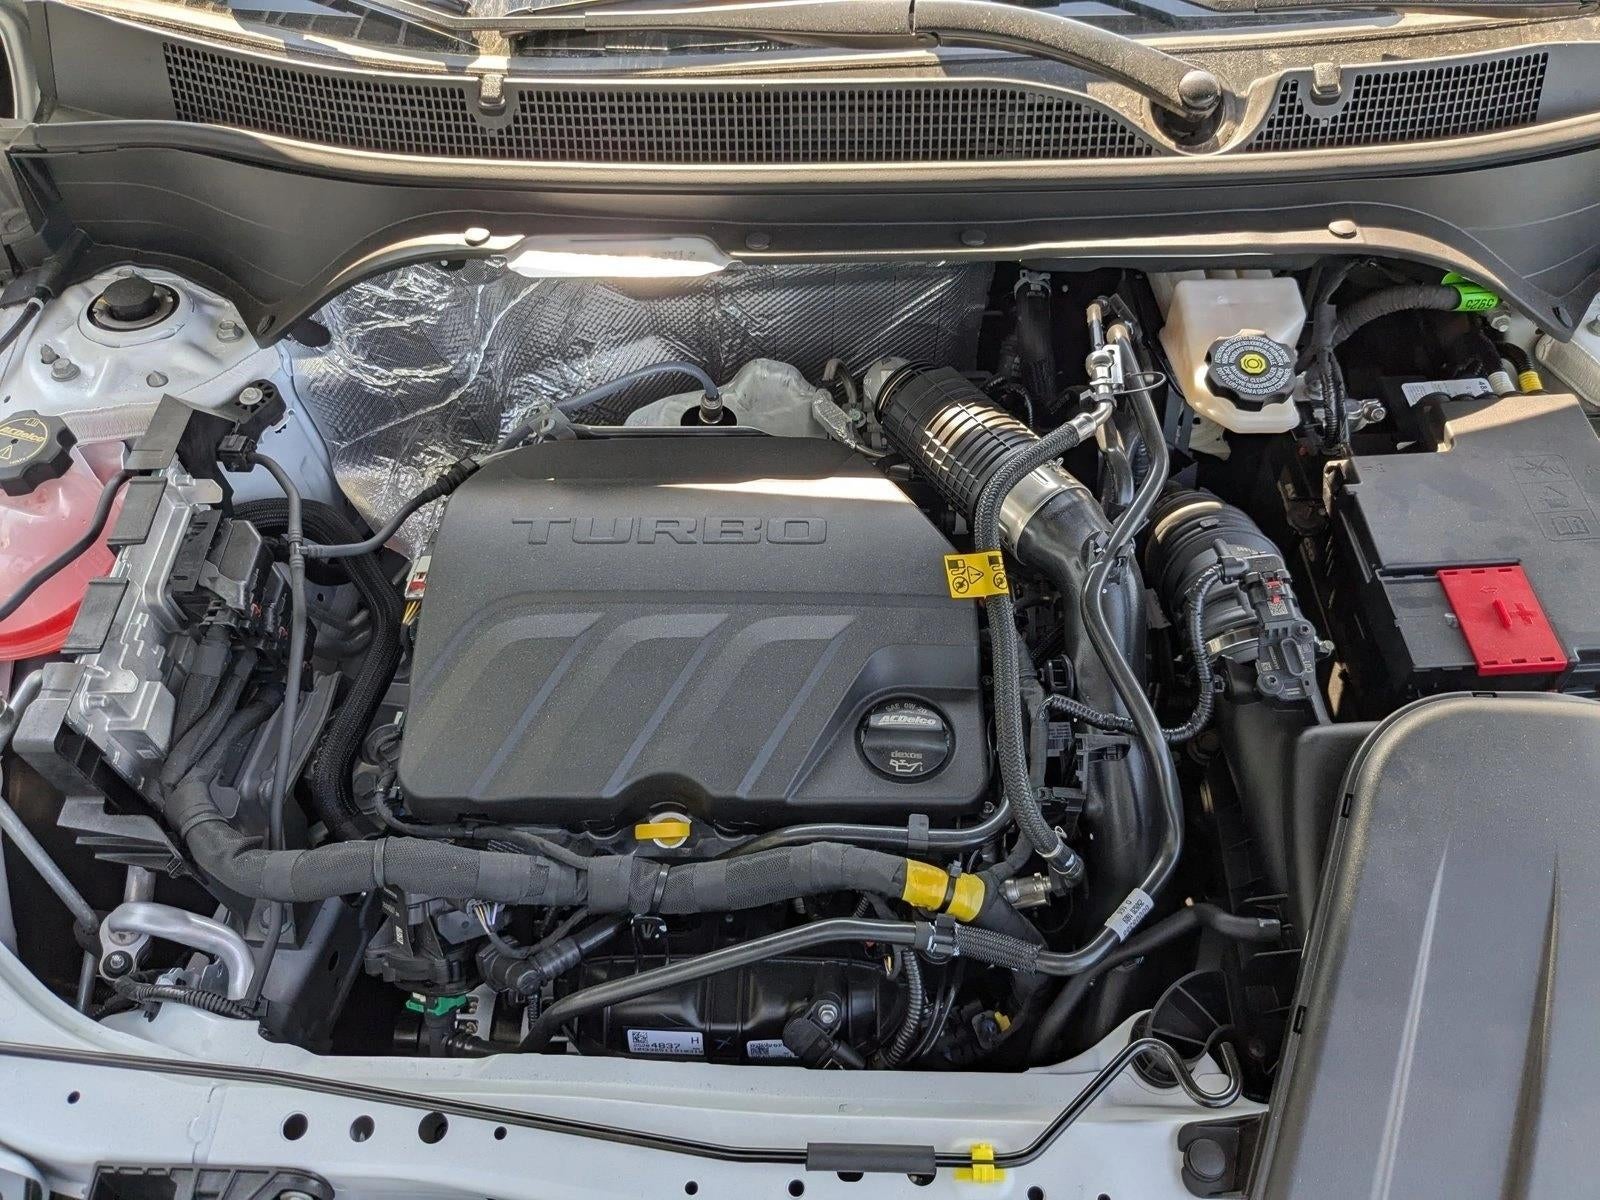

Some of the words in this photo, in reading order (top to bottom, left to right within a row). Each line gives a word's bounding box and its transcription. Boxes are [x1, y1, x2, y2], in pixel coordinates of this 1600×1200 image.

[1465, 298, 1494, 310] 5925
[1224, 377, 1237, 388] FLUID
[1237, 385, 1252, 394] FROM
[511, 516, 827, 545] TURBO
[878, 714, 936, 726] ACDelco
[890, 750, 923, 759] dexos
